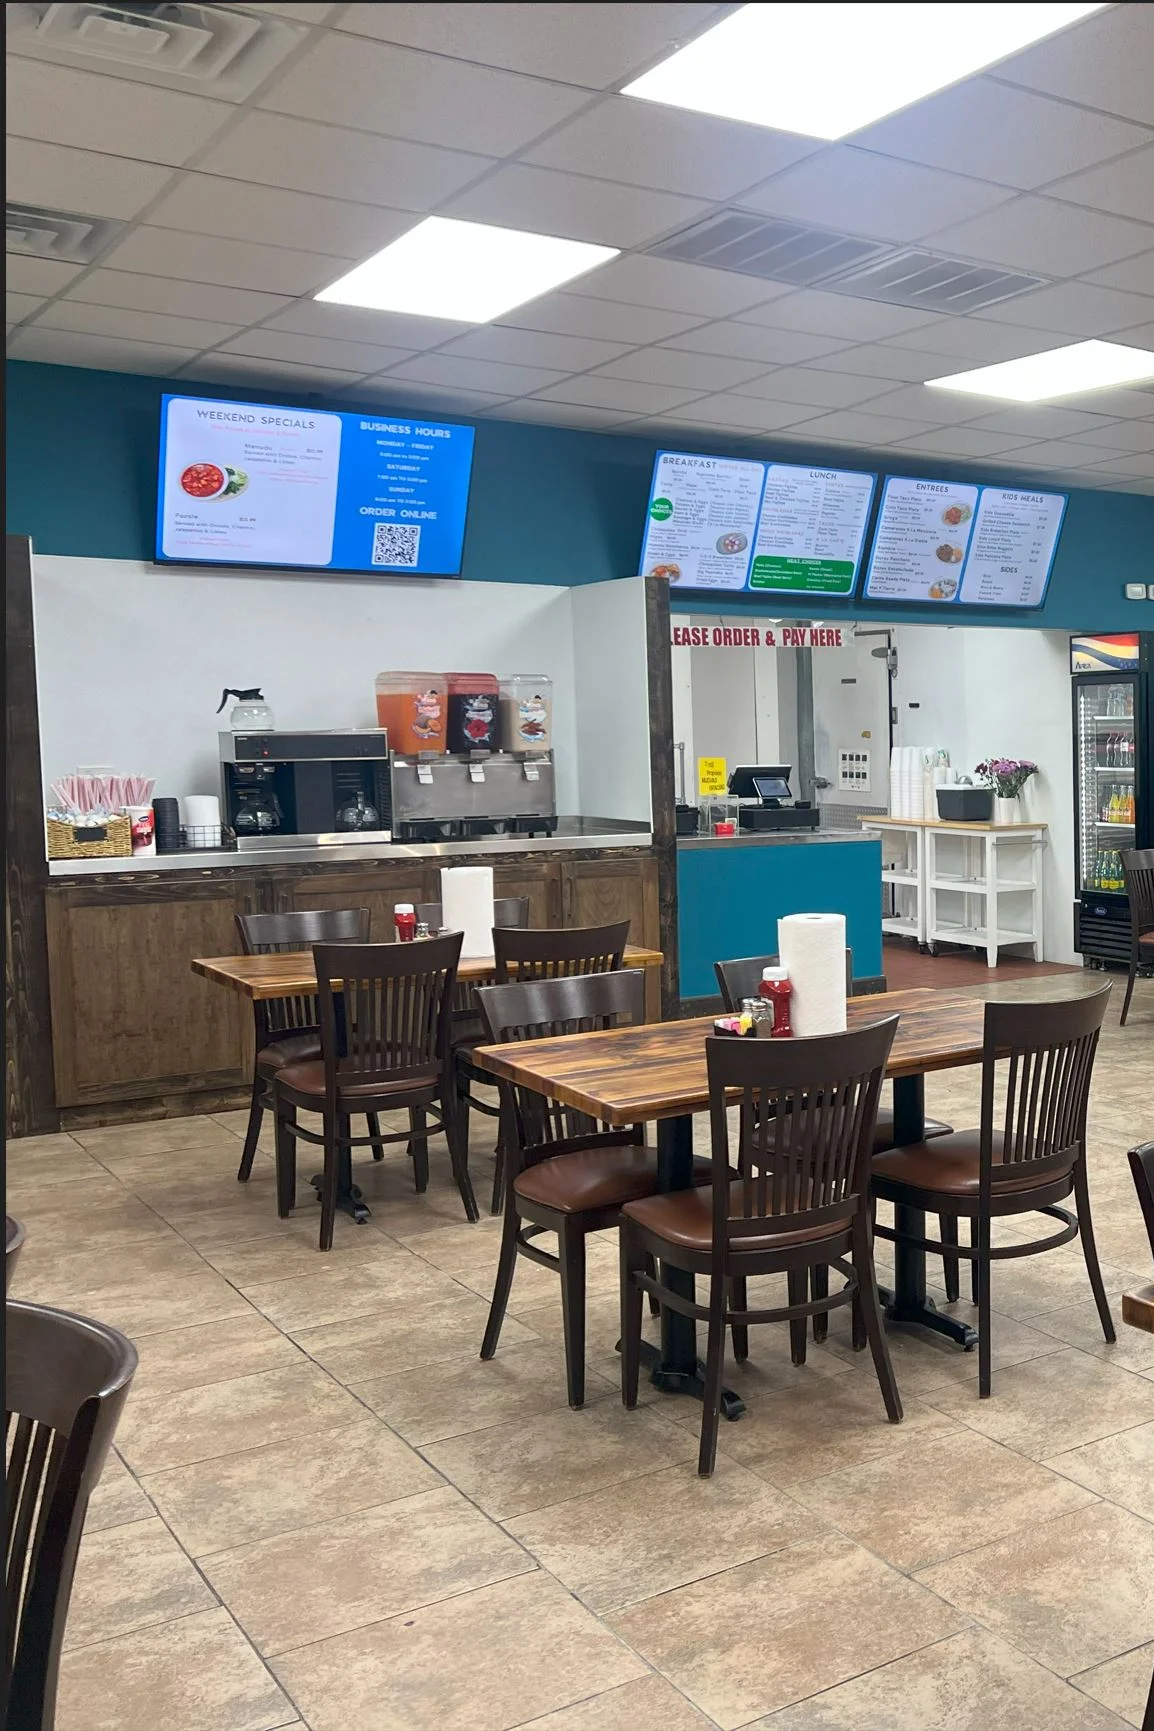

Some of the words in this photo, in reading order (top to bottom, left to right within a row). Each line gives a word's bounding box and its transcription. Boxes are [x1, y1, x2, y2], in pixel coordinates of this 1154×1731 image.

[197, 409, 255, 423] WEEKEND
[261, 416, 315, 429] SPECIALS
[360, 421, 411, 434] BUSINESS
[415, 427, 451, 438] HOURS
[662, 457, 717, 469] BREAKFAST
[810, 471, 837, 480] LUNCH
[916, 483, 949, 493] ENTREES
[1002, 493, 1018, 501] KIDS
[1020, 495, 1044, 503] MEALS
[359, 507, 396, 517] ORDER
[400, 509, 437, 519] ONLINE
[670, 627, 709, 646] EASE
[713, 628, 760, 646] ORDER
[765, 630, 775, 646] &
[783, 629, 806, 646] PAY
[810, 629, 842, 646] HERE
